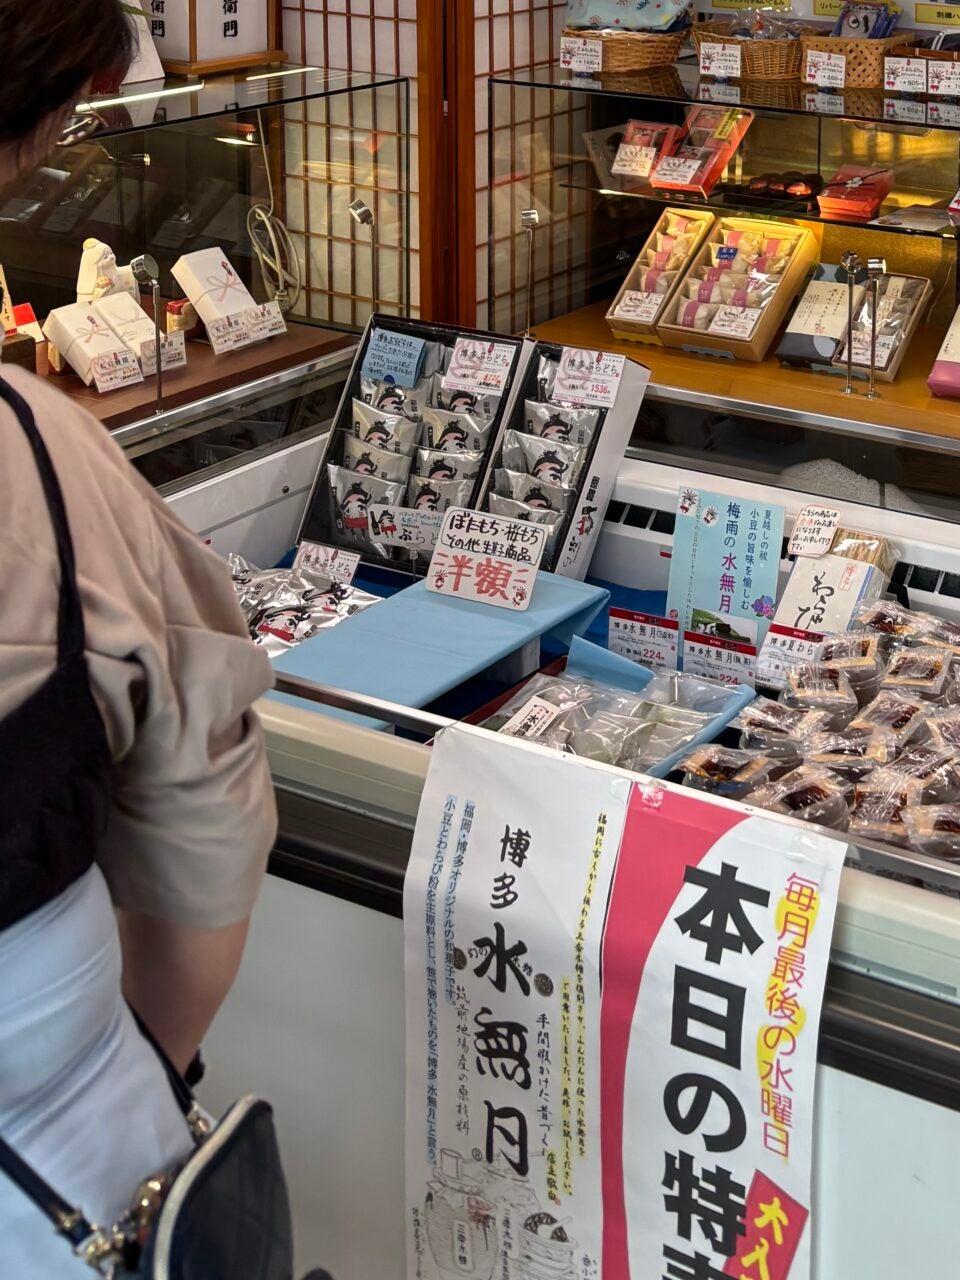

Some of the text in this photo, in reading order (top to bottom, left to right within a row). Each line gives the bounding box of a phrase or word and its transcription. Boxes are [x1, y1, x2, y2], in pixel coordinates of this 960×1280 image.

[447, 554, 513, 601] 半額
[760, 872, 819, 1158] 毎月最後の水曜日
